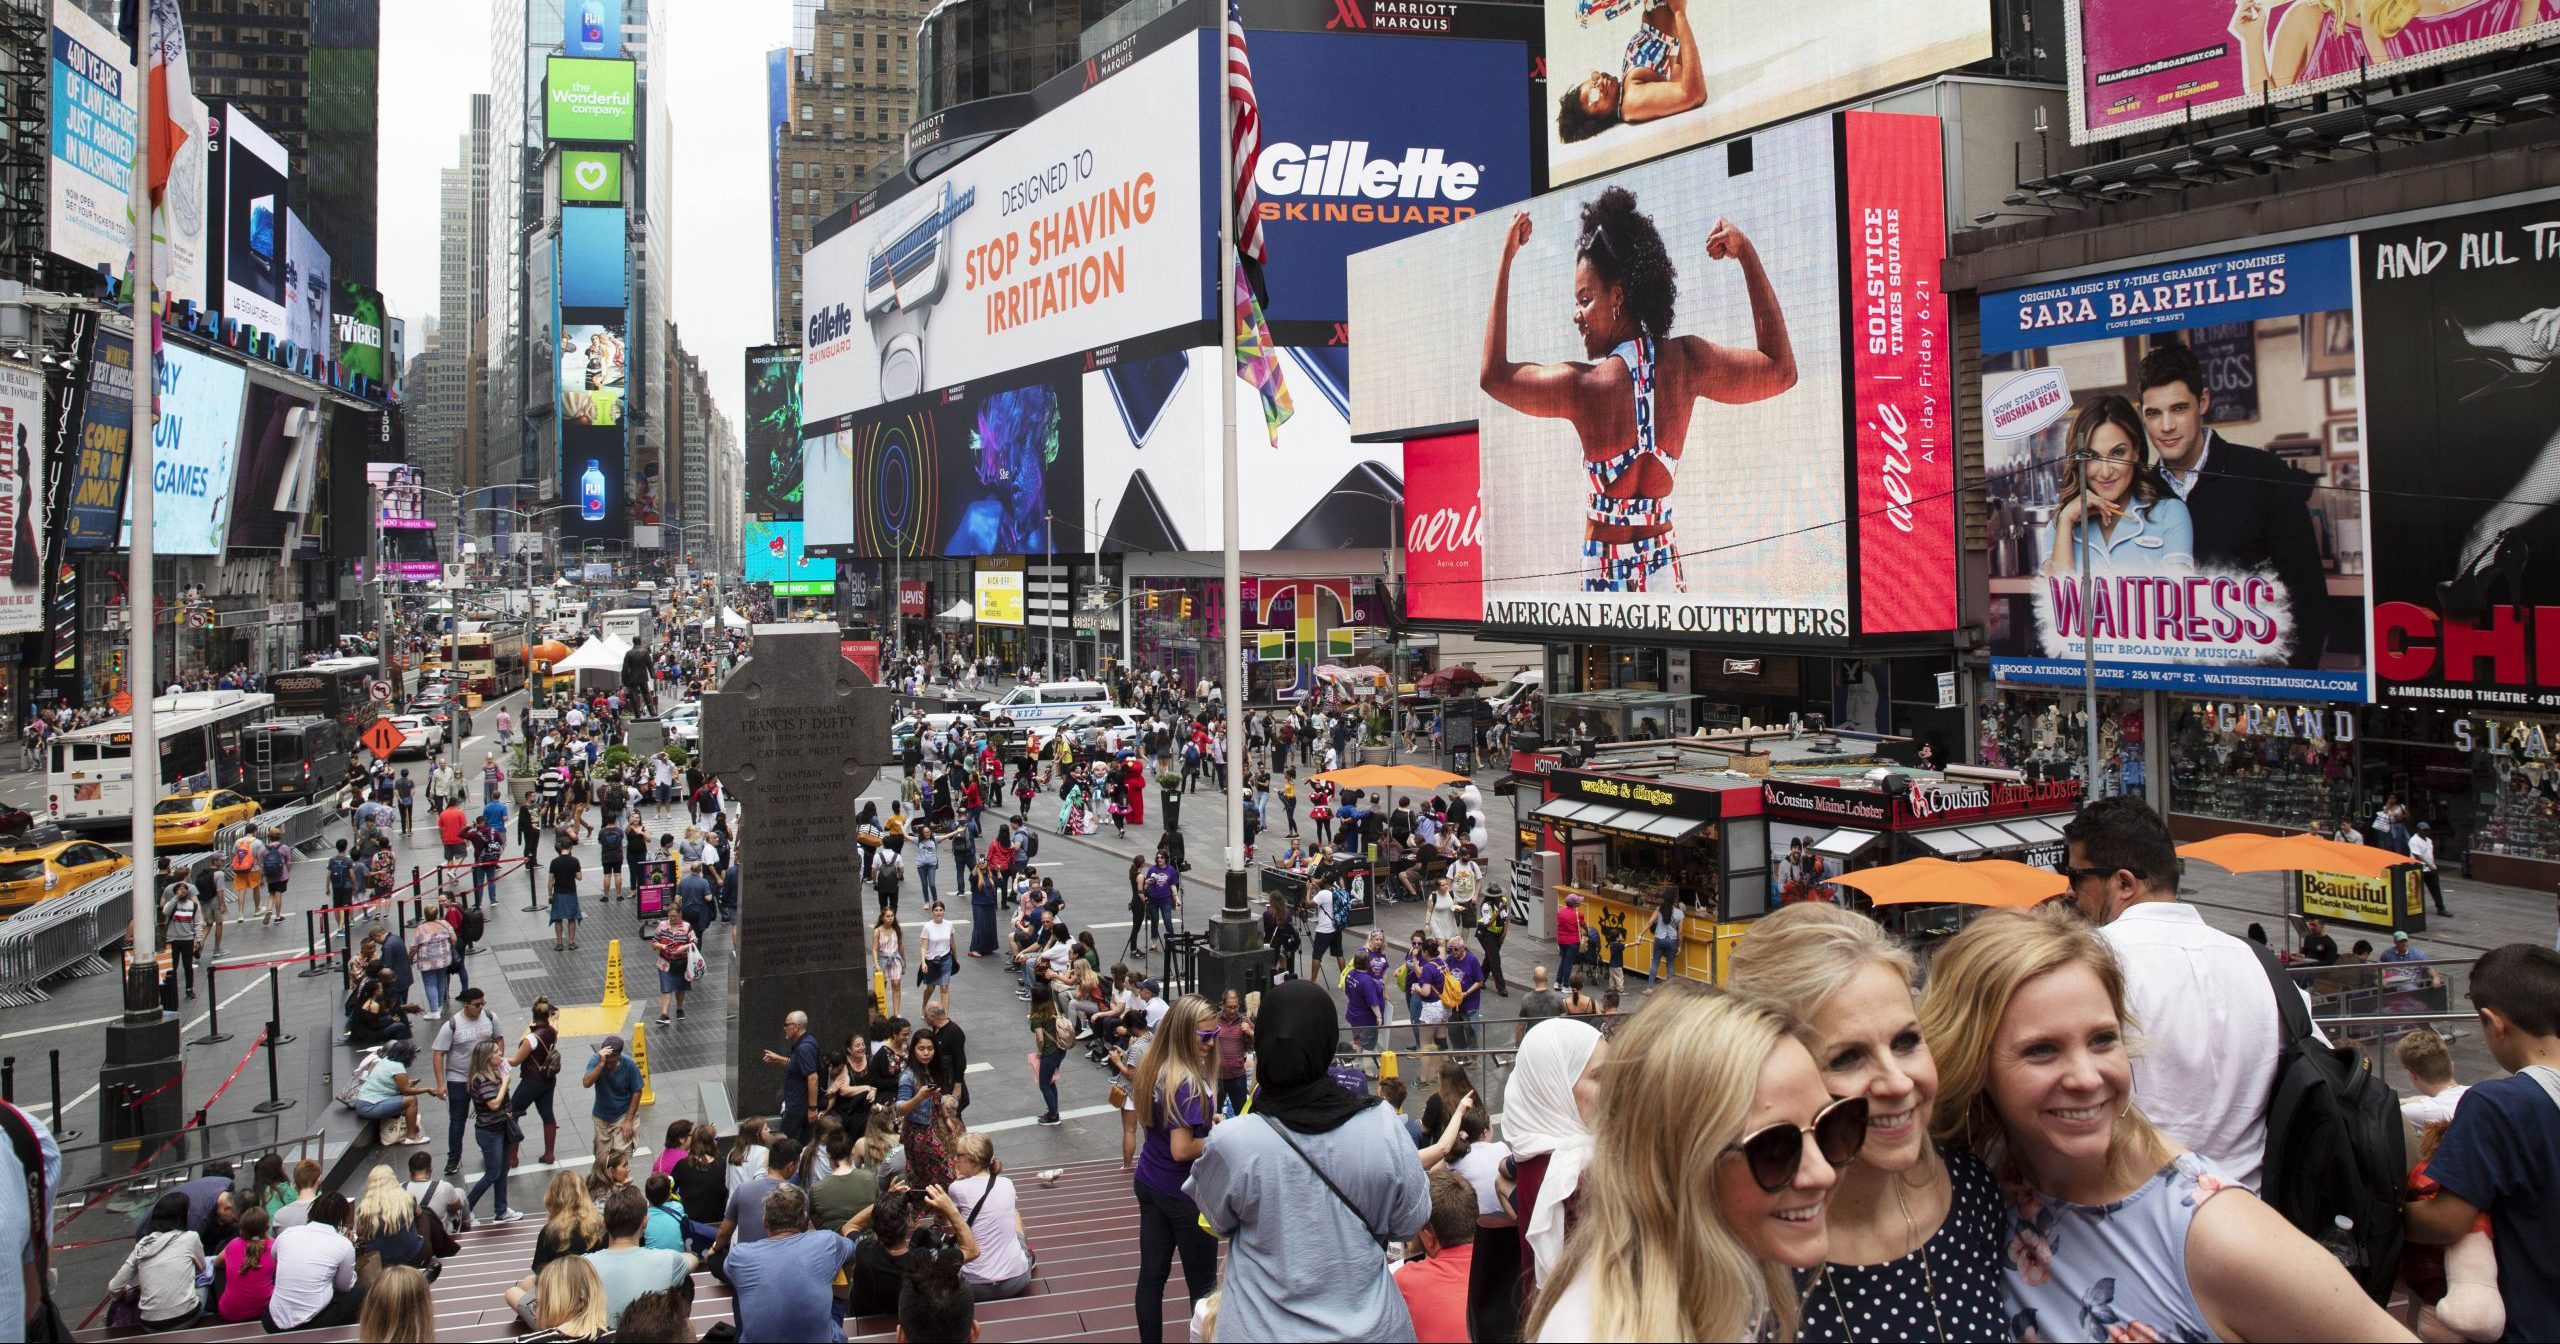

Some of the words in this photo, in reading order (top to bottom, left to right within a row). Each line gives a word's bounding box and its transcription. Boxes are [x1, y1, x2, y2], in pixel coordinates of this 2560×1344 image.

[1375, 1, 1457, 17] MARRIOTT
[1375, 17, 1448, 31] MARQUIS
[1101, 34, 1137, 63] MARRIOTT
[67, 40, 86, 76] 400
[87, 52, 118, 97] YEARS
[1101, 51, 1133, 76] MARQUIS
[67, 71, 80, 101] OF
[81, 79, 103, 117] LAW
[552, 89, 630, 105] Wonderful
[572, 81, 590, 92] the
[2157, 92, 2174, 103] JEFF
[2175, 81, 2219, 99] RICHMOND
[2176, 82, 2192, 90] MUSIC
[2106, 104, 2126, 116] TINA
[2127, 101, 2142, 112] FEY
[66, 104, 92, 141] JUST
[93, 119, 132, 164] ARRIVED
[911, 114, 945, 138] MARRIOTT
[911, 129, 940, 149] MARQUIS
[66, 134, 78, 164] IN
[208, 141, 218, 151] G
[1002, 162, 1068, 217] DESIGNED
[1073, 149, 1093, 183] TO
[1254, 140, 1479, 201] Gillette
[1258, 202, 1478, 225] SKINGUARD
[966, 230, 1018, 291] STOP
[1029, 172, 1156, 267] SHAVING
[1887, 208, 1902, 287] SQUARE
[2376, 240, 2448, 281] AND
[2460, 231, 2519, 271] ALL
[986, 246, 1125, 335] IRRITATION
[1864, 207, 1887, 355] SOLSTICE
[2019, 286, 2069, 304] ORIGINAL
[2071, 281, 2104, 298] MUSIC
[2106, 279, 2121, 291] BY
[2123, 274, 2160, 290] 7-TIME
[2226, 253, 2286, 273] NOMINEE
[1916, 279, 1930, 321] 6.21
[2019, 298, 2098, 330] SARA
[2109, 268, 2287, 318] BAREILLES
[809, 302, 851, 348] Gillette
[1890, 290, 1905, 356] TIMES
[247, 322, 369, 399] BROADWAY
[809, 339, 851, 365] SKINGUARD
[1918, 329, 1937, 388] Friday
[7, 373, 30, 387] REALLY
[11, 387, 38, 401] TONIGHT
[1992, 401, 2012, 416] NOW
[2015, 380, 2057, 406] STARRING
[1995, 399, 2039, 428] SHOSHANA
[2038, 389, 2061, 409] BEAN
[1920, 398, 1937, 430] day
[84, 422, 127, 455] COME
[1921, 438, 1935, 464] All
[79, 448, 124, 481] FROM
[153, 460, 209, 498] GAMES
[1868, 402, 1914, 533] aerie
[74, 478, 120, 507] AWAY
[851, 572, 866, 593] BIG
[851, 593, 866, 607] BOLD
[2048, 576, 2278, 645] WAITRESS
[1483, 601, 1592, 628] AMERICAN
[1599, 602, 1672, 630] EAGLE
[1678, 605, 1847, 637] OUTFITTERS
[2093, 643, 2114, 655] HIT
[2118, 644, 2190, 658] BROADWAY
[2195, 647, 2257, 660] MUSICAL
[1241, 648, 1249, 701] #UnlimitedPride
[1999, 664, 2033, 675] BROOKS
[2034, 665, 2082, 677] ATKINSON
[2083, 667, 2125, 679] TEATRE
[2131, 671, 2149, 680] 256
[2183, 673, 2197, 683] ST.
[2203, 674, 2358, 691] WAITRESSTHEMUSICAL.COM
[2398, 686, 2473, 700] AMBASSADOR
[2476, 690, 2528, 704] THEATRE
[741, 719, 795, 732] FRANCIS
[812, 716, 856, 730] DUFFY
[1016, 709, 1042, 718] NYPD
[2217, 703, 2354, 742] GRAND
[757, 749, 801, 759] CATHOLIC
[808, 746, 841, 756] PRIEST
[777, 770, 822, 780] CHAPLAIN
[803, 781, 842, 790] INFANTRY
[1580, 780, 1618, 797] wafels
[1620, 783, 1631, 798] &
[1633, 785, 1674, 805] dinges
[1776, 789, 1813, 809] Cousins
[1814, 795, 1846, 814] Maine
[1845, 800, 1884, 819] Lobster
[1929, 789, 1989, 813] Cousins
[1990, 782, 2033, 807] Maine
[2033, 778, 2085, 802] Lobster
[807, 814, 844, 825] SERVICE
[780, 835, 801, 845] AND
[803, 832, 847, 843] COUNTRY
[2027, 852, 2064, 867] ARKET
[2304, 873, 2388, 905] Beautiful
[2305, 896, 2319, 905] The
[2319, 898, 2342, 908] Carole
[2342, 901, 2361, 913] King
[2361, 903, 2388, 915] Musical
